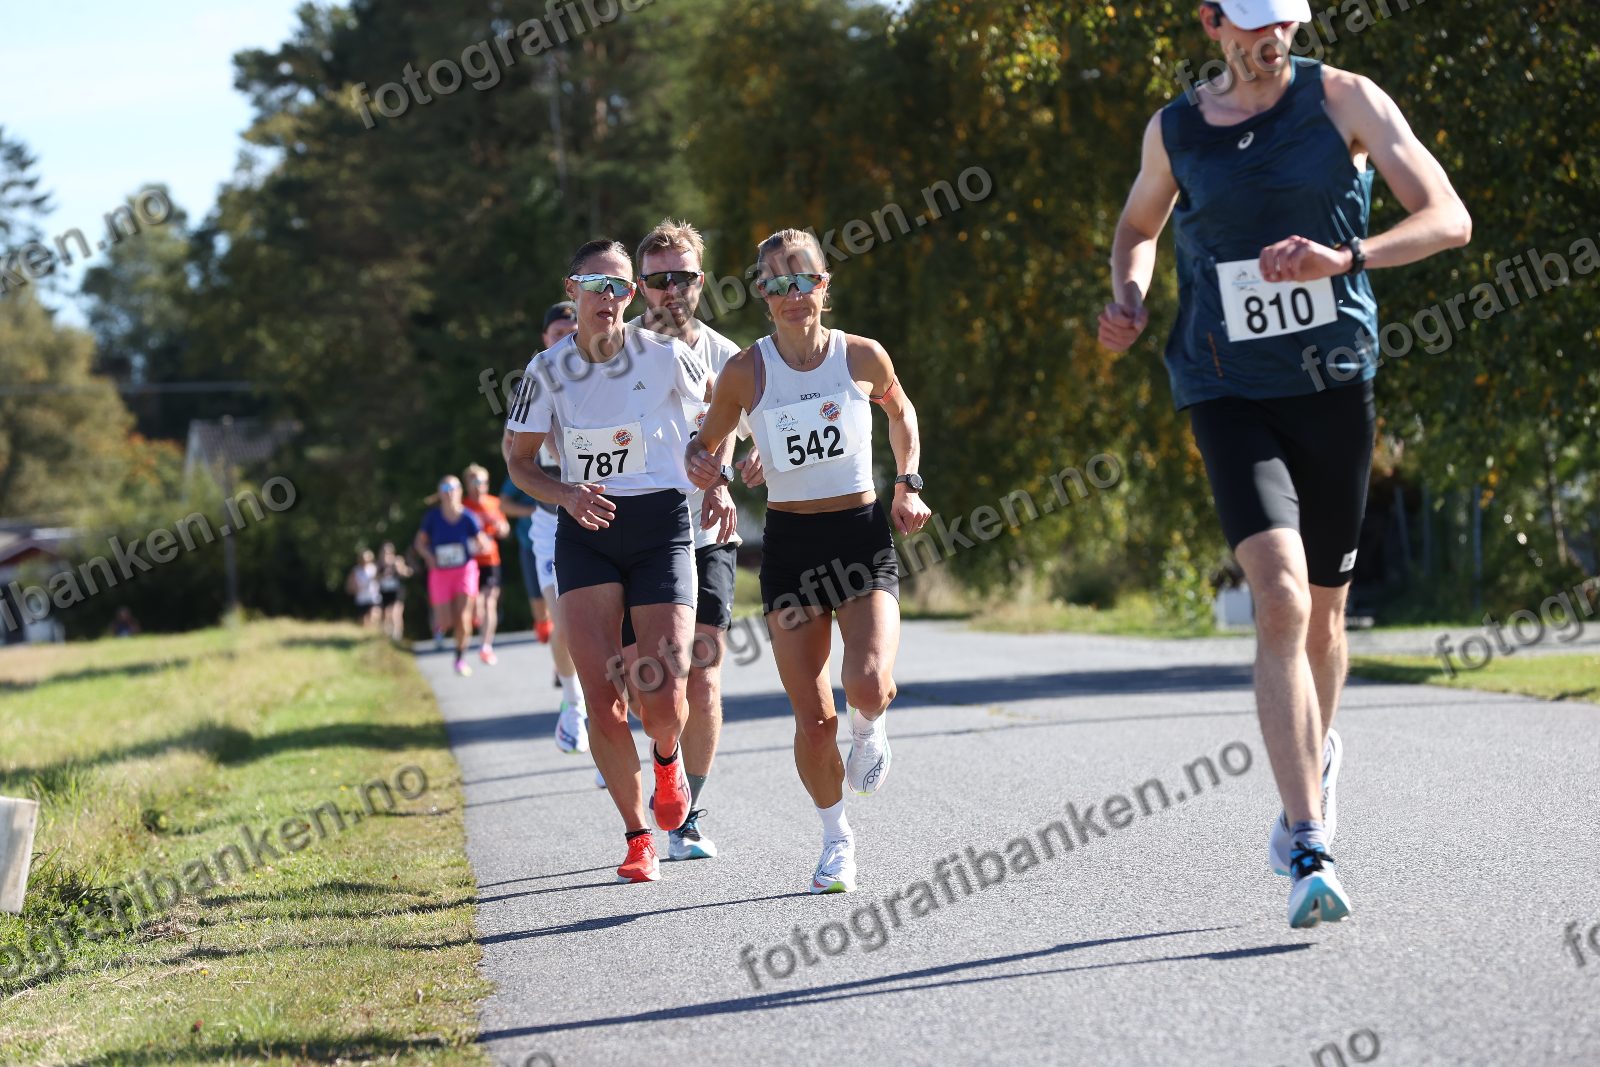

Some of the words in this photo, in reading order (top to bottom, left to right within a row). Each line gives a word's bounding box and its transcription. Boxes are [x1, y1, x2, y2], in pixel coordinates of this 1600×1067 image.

[1244, 287, 1314, 334] 810
[577, 448, 629, 480] 787
[786, 425, 844, 466] 542
